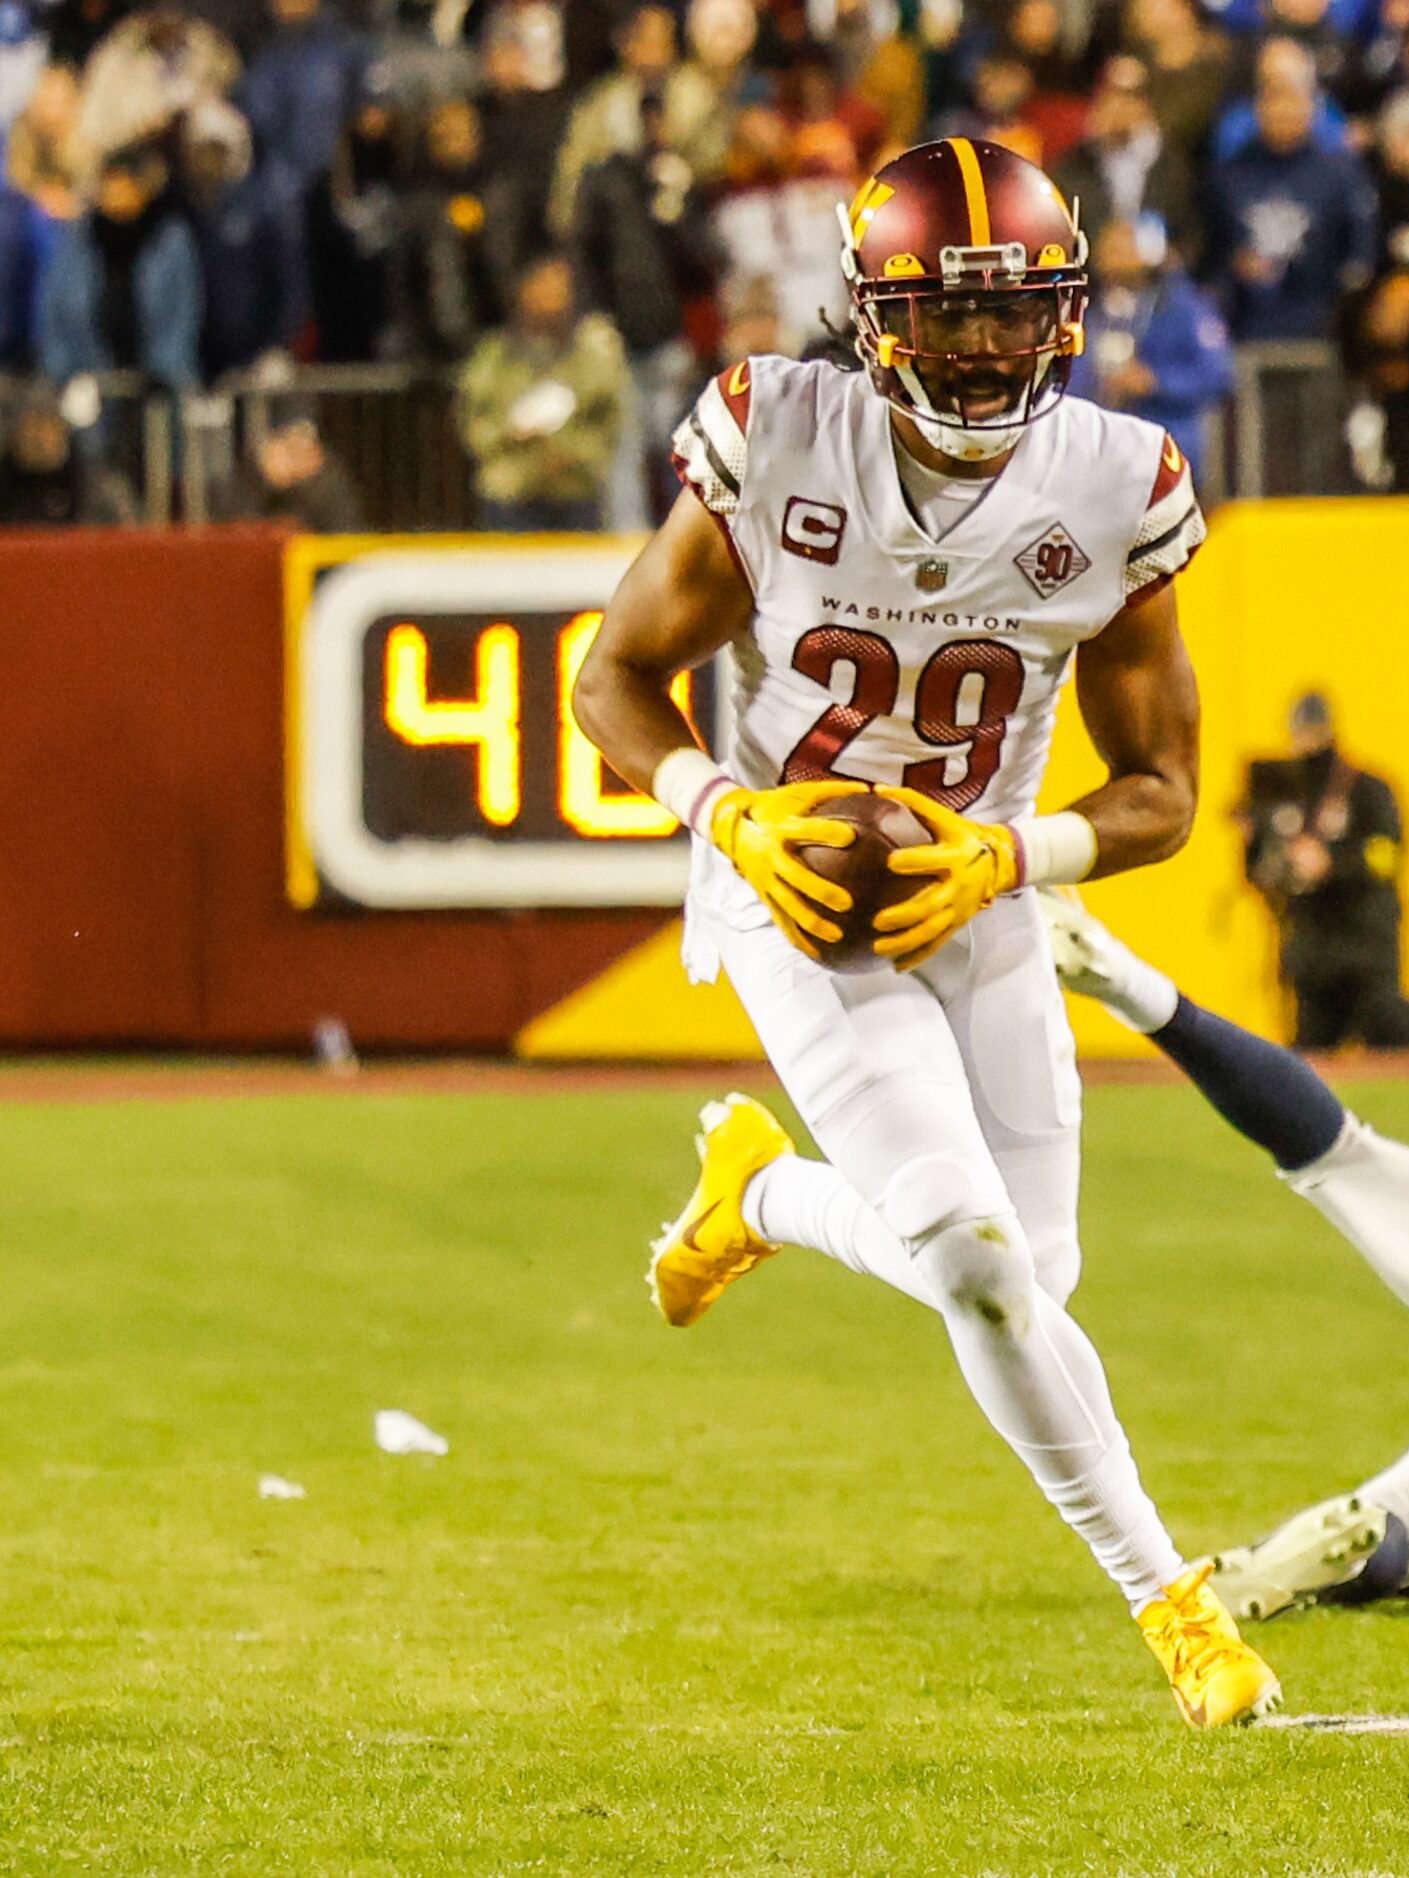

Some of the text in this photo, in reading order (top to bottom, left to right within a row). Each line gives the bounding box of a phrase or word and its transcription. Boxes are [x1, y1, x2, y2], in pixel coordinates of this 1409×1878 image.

[786, 503, 841, 549] C
[1035, 543, 1073, 581] 90
[822, 595, 1021, 631] WASHINGTON
[779, 624, 1025, 812] 29
